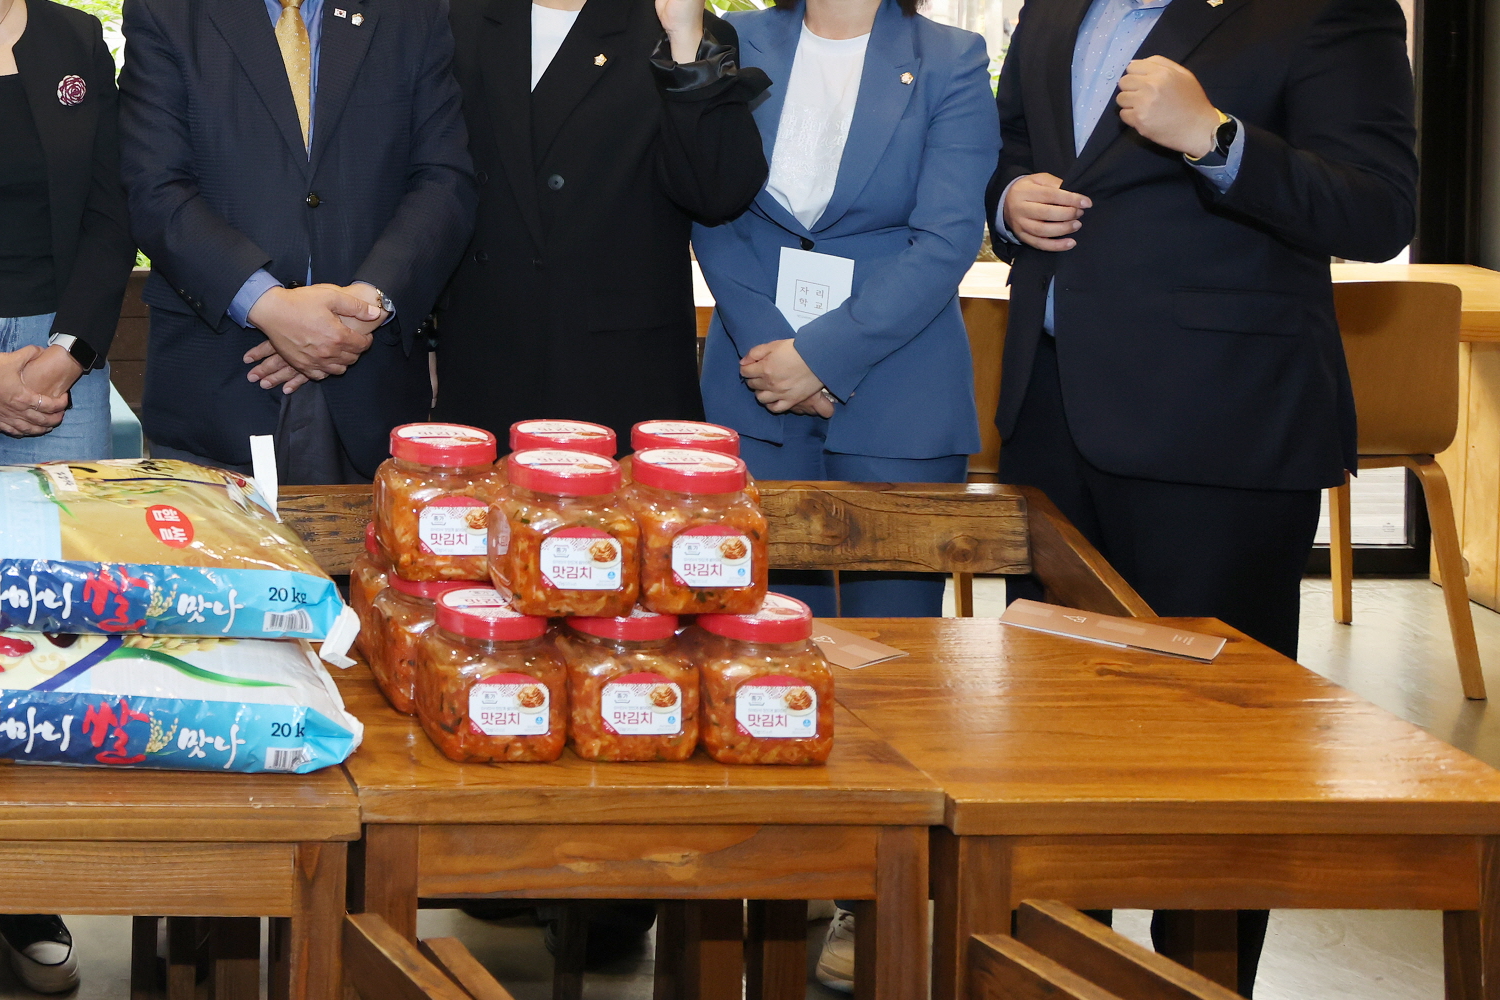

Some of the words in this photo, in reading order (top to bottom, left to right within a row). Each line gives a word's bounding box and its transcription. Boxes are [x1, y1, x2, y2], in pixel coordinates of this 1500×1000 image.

[151, 508, 188, 543] 햅쌀
[430, 533, 468, 546] 맛김치
[552, 566, 592, 579] 맛김치
[683, 563, 723, 577] 맛김치
[83, 566, 148, 632] 쌀
[268, 587, 289, 602] 20
[291, 588, 307, 604] kg
[177, 589, 244, 633] 맛나
[481, 712, 520, 726] 맛김치
[613, 711, 653, 725] 맛김치
[748, 714, 787, 728] 맛김치
[82, 699, 150, 764] 쌀
[271, 722, 292, 737] 20
[177, 723, 246, 769] 맛나
